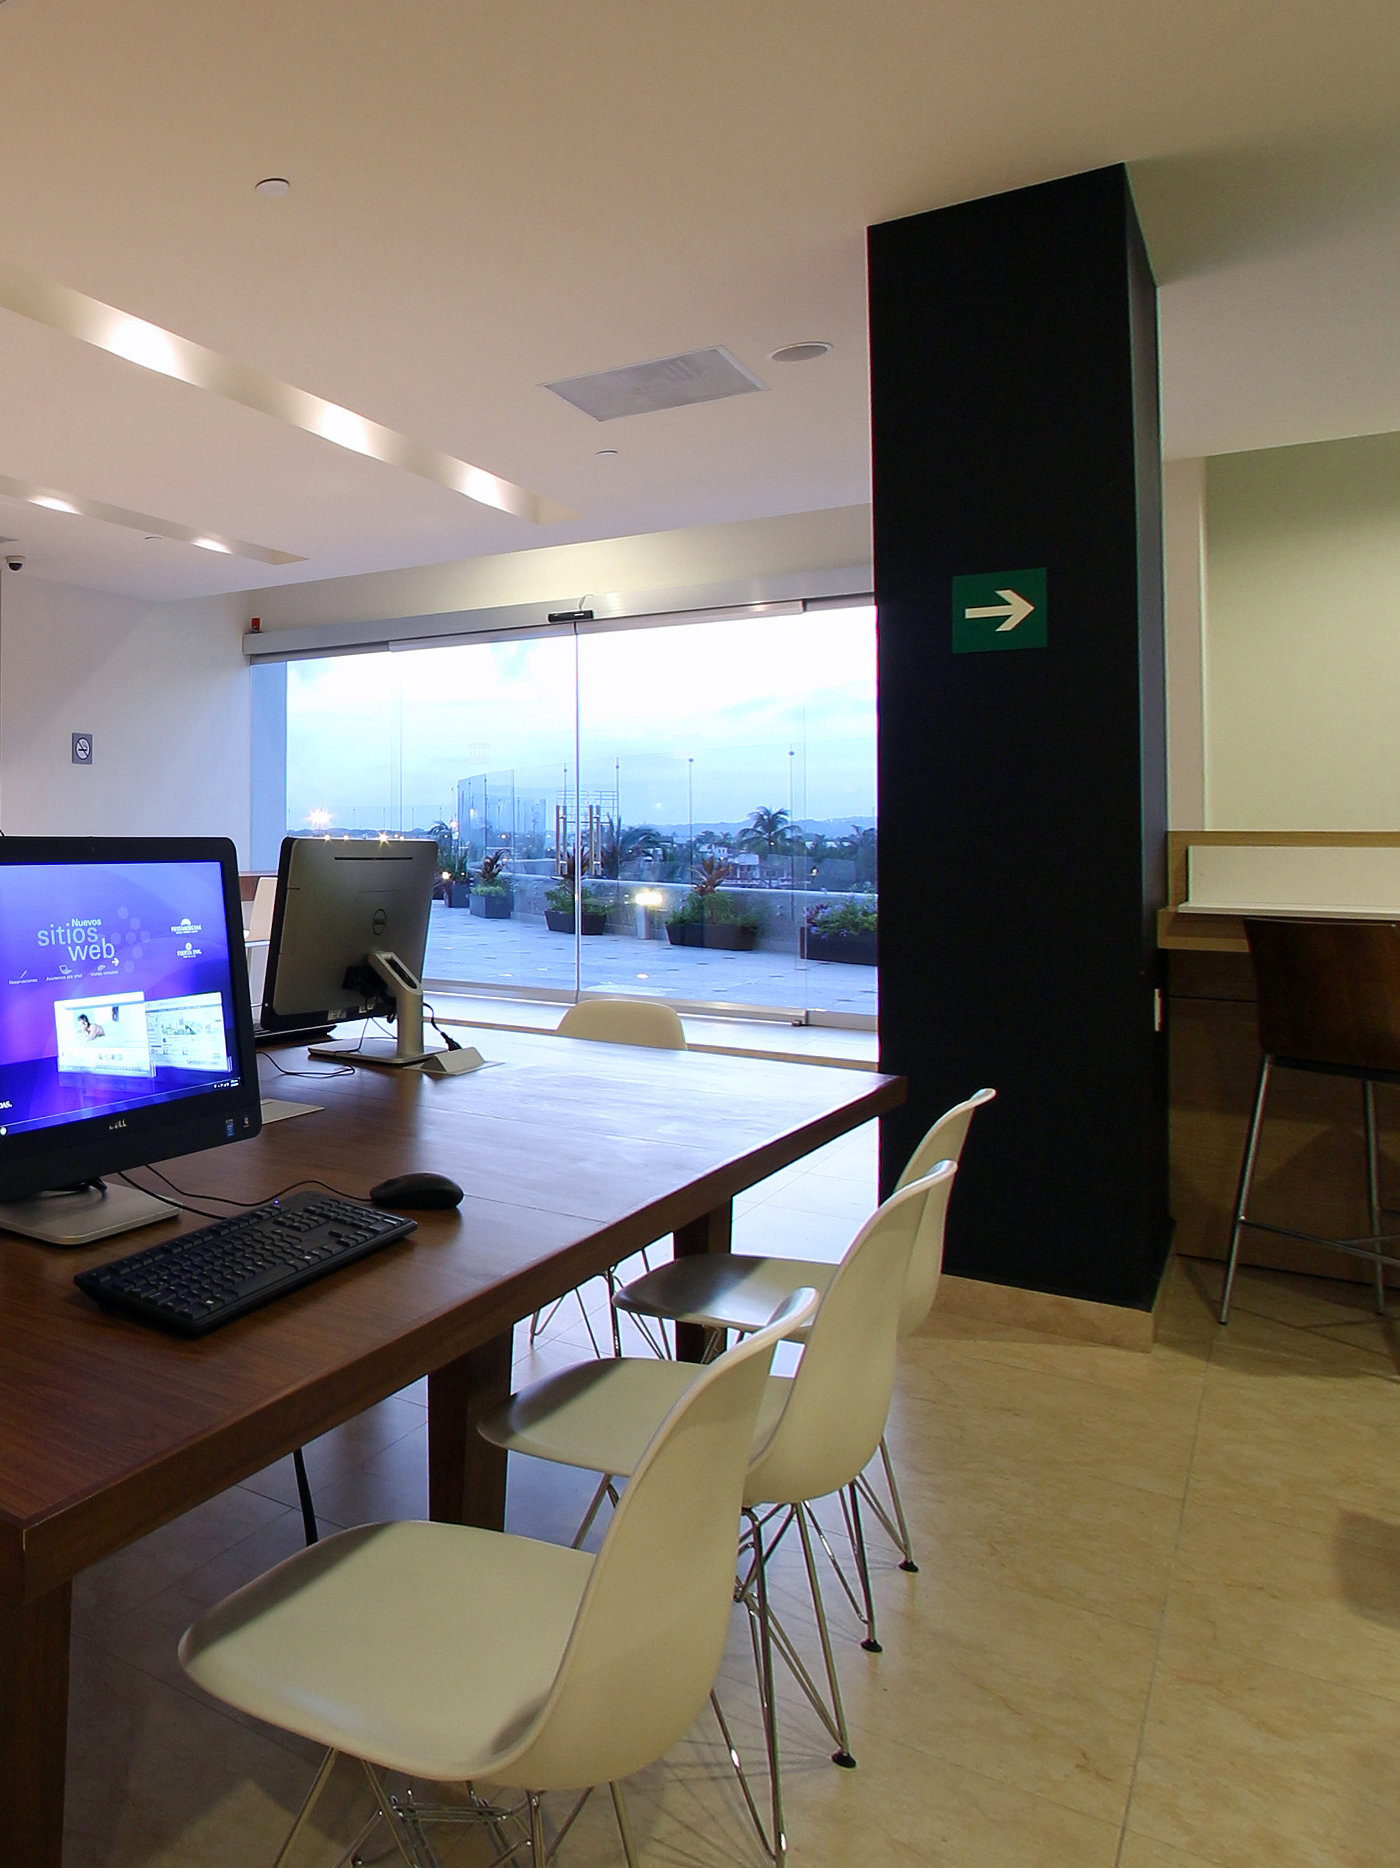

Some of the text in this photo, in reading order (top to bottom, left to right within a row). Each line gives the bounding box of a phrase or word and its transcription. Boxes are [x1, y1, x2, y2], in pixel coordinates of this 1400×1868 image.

[37, 923, 98, 946] sitios
[72, 919, 102, 927] Nuevos
[68, 938, 115, 961] web
